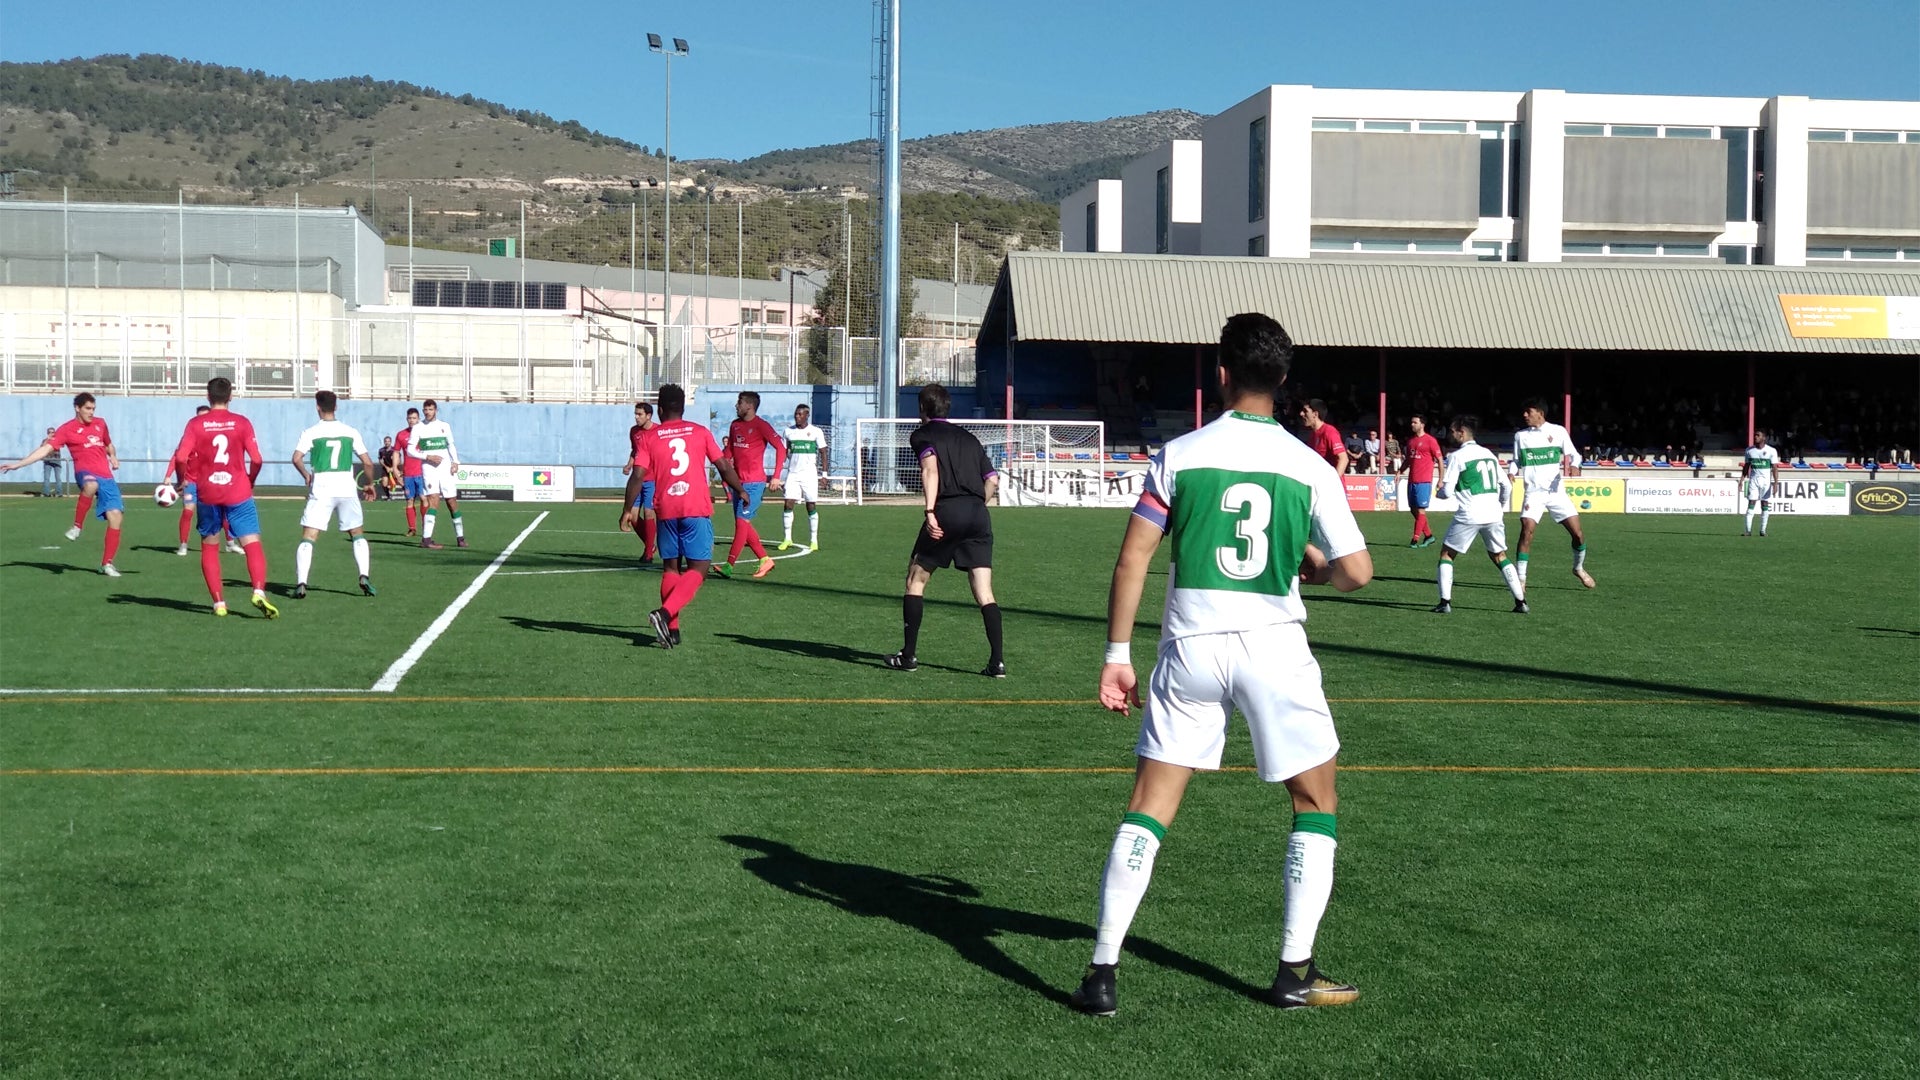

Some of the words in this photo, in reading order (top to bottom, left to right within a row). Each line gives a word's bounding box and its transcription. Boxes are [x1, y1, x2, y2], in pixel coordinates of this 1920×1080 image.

[211, 433, 230, 466] 2
[325, 440, 342, 470] 7
[668, 437, 690, 477] 3
[1475, 460, 1498, 491] 11
[1628, 487, 1673, 497] limpiezas
[1678, 488, 1715, 498] GARVI,
[1215, 482, 1273, 581] 3
